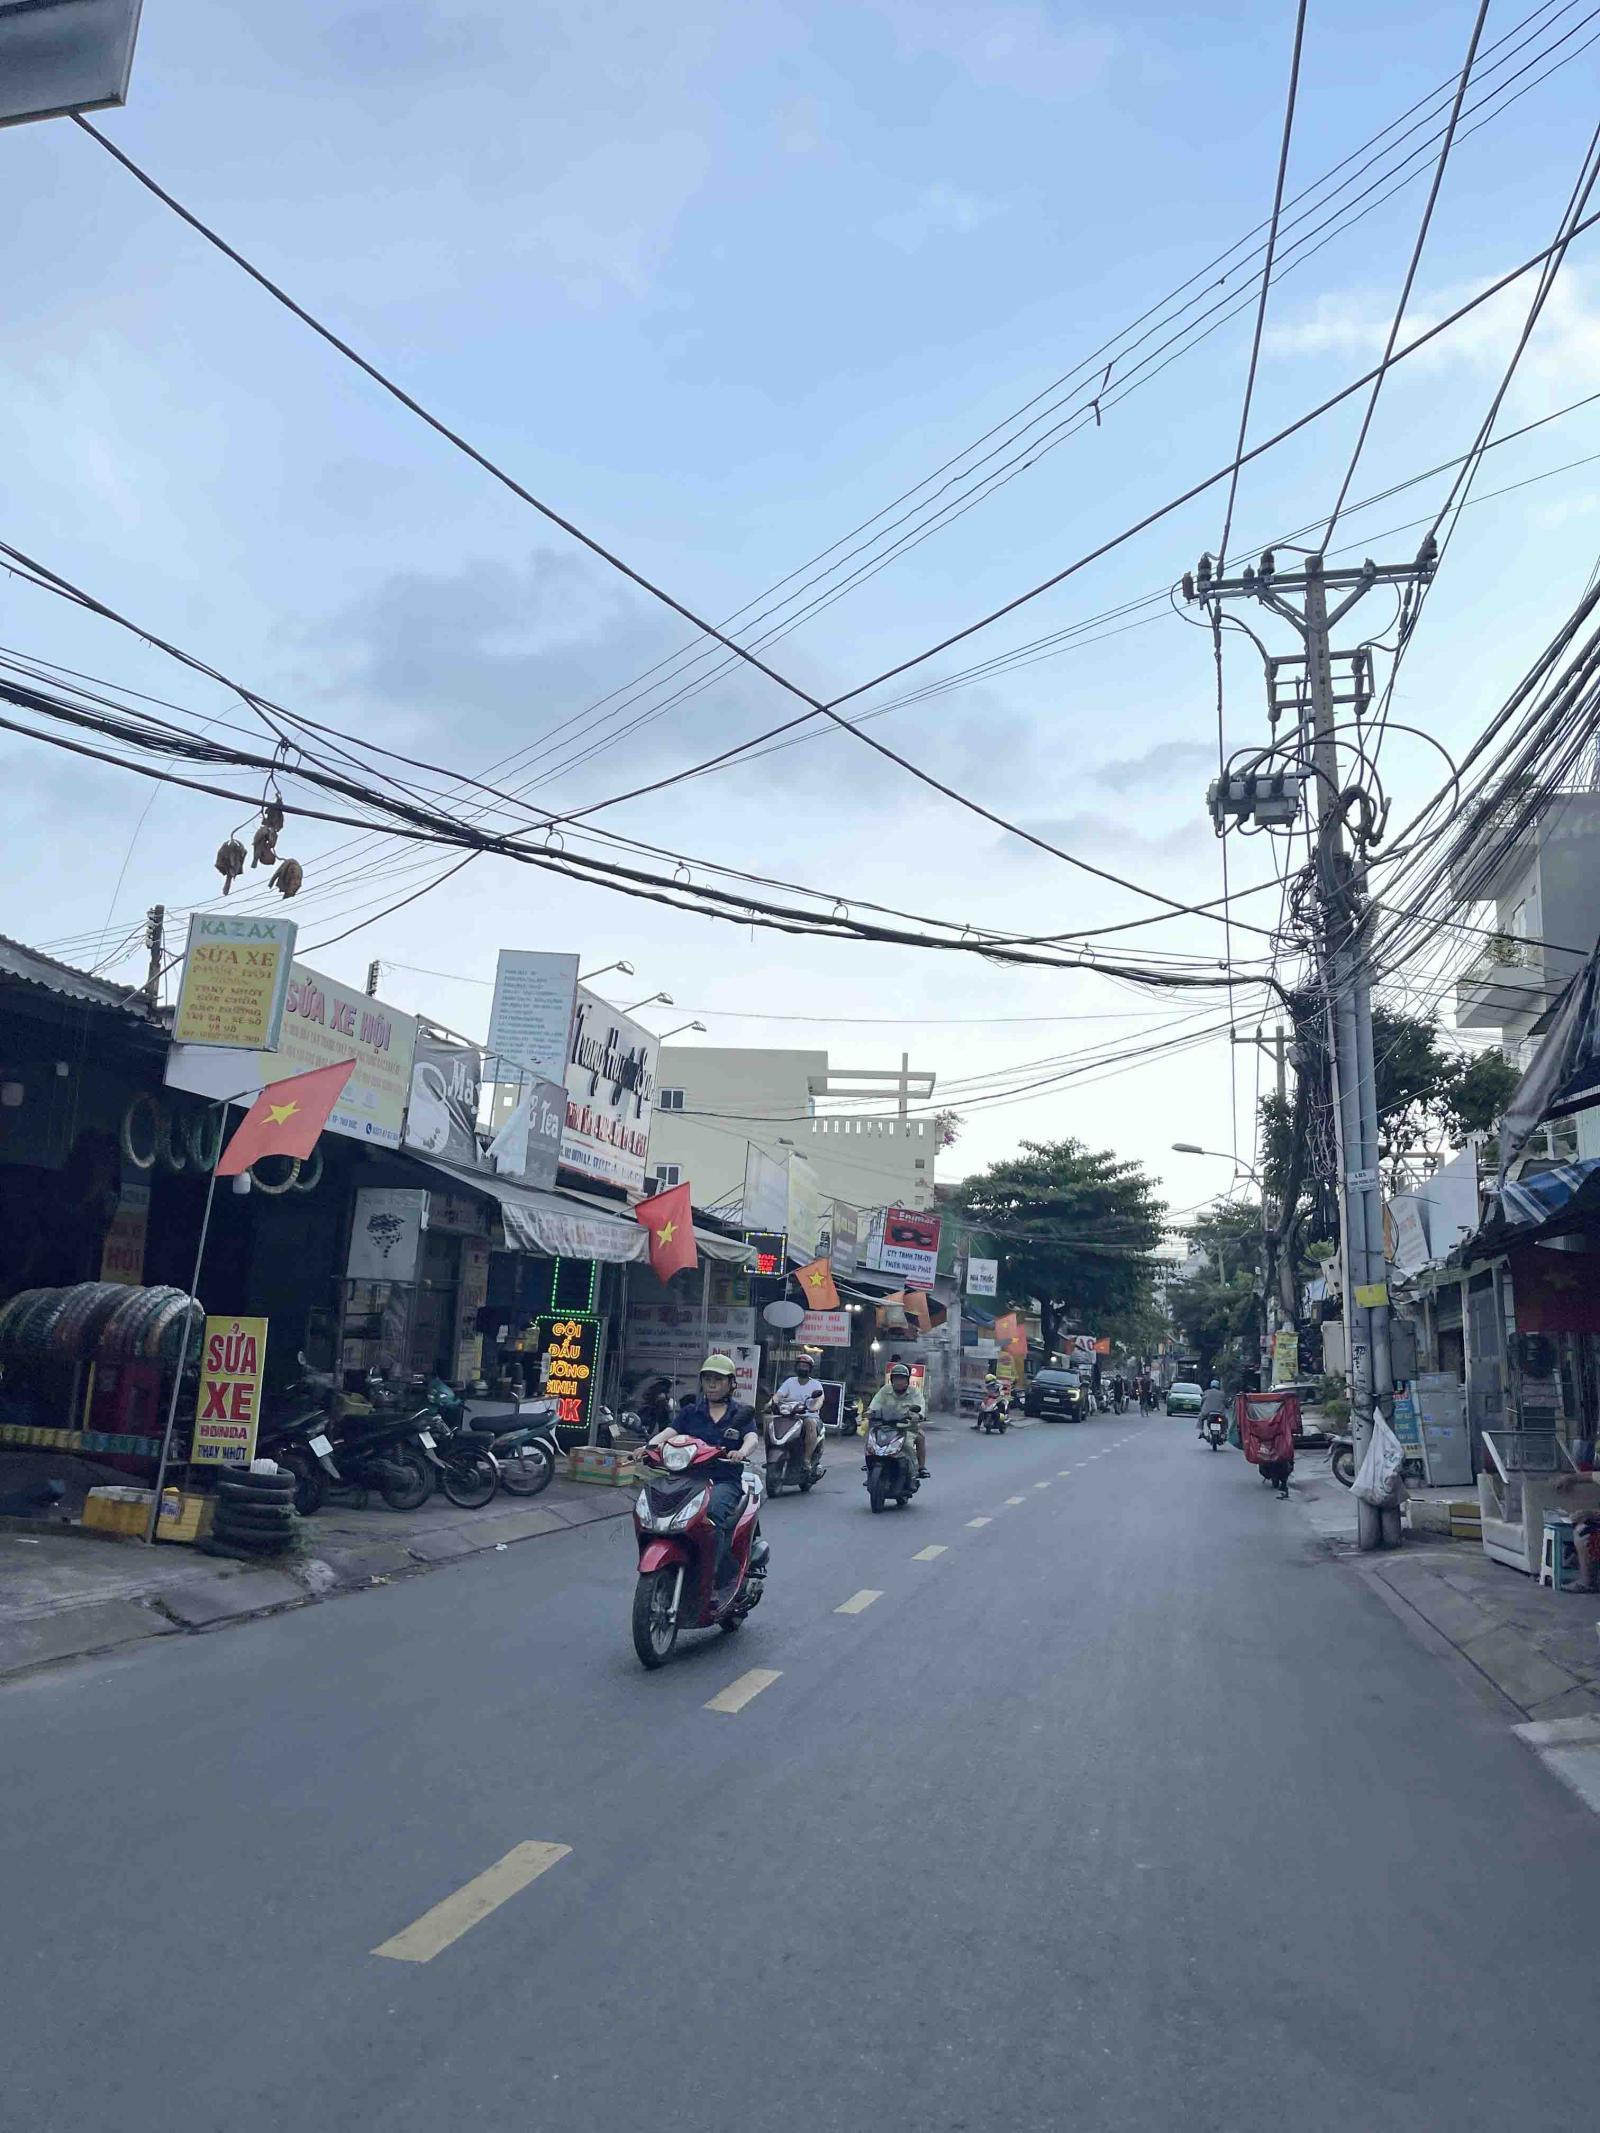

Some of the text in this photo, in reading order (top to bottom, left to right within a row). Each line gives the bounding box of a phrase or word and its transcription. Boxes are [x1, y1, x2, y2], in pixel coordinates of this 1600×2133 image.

[246, 951, 275, 967] XE
[286, 976, 325, 1025] SỬA
[330, 998, 358, 1038] XE
[207, 1322, 257, 1376] SỬA
[548, 1338, 581, 1359] ĐẦU
[202, 1381, 255, 1421] XE
[200, 1424, 248, 1440] HONDA
